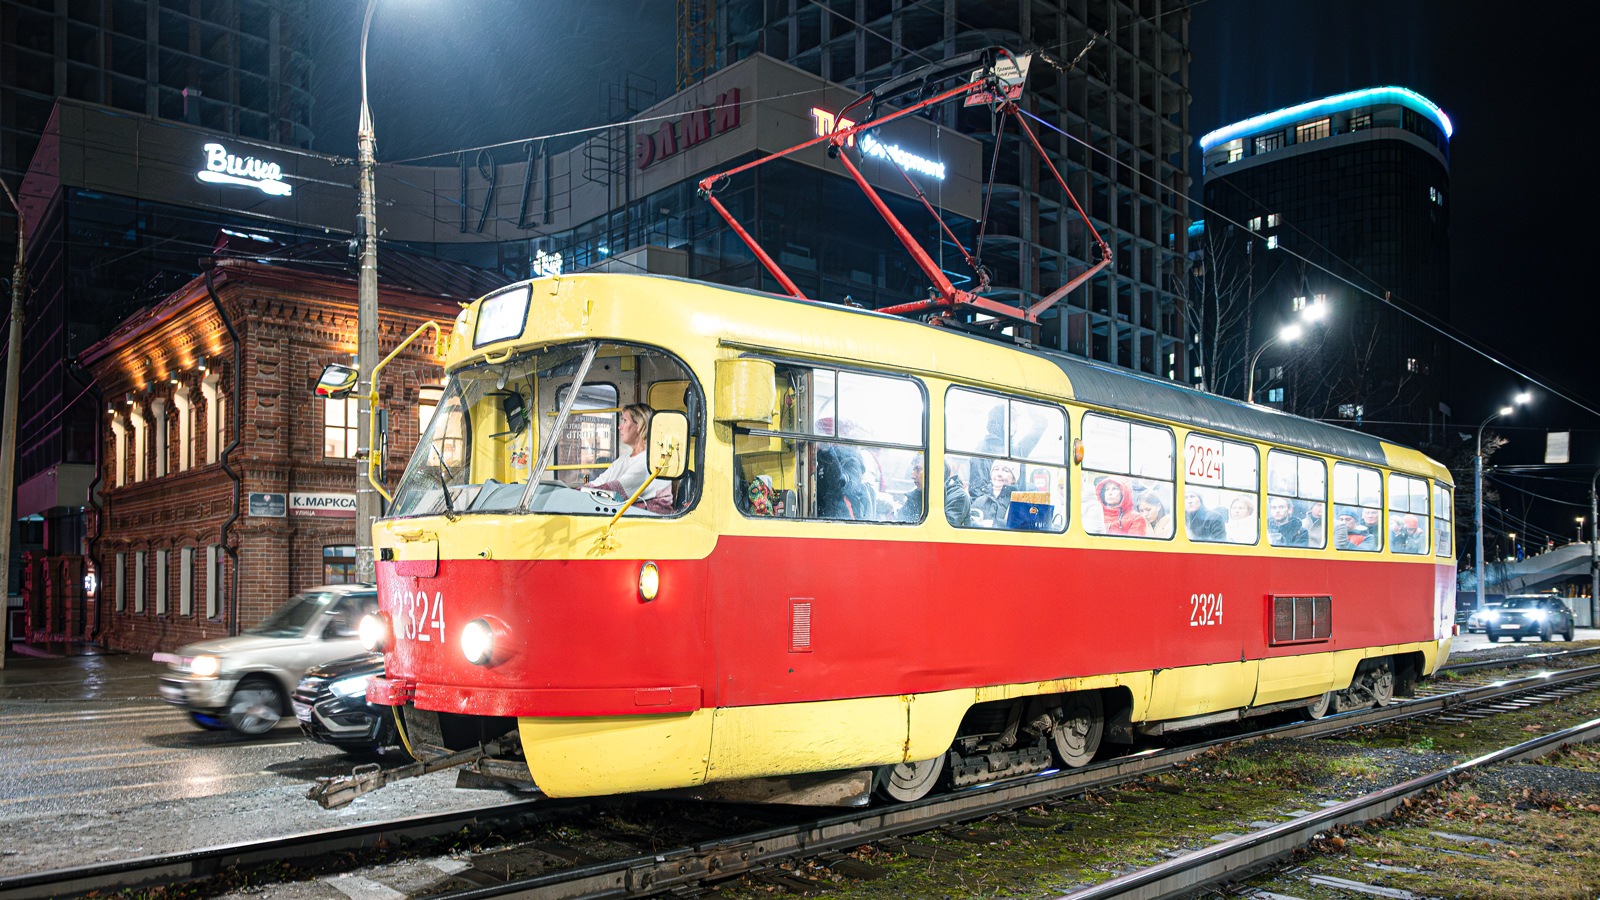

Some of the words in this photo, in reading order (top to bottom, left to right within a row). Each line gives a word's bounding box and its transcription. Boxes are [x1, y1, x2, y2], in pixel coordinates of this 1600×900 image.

[456, 138, 549, 233] 1921
[1189, 445, 1220, 479] 2324
[393, 591, 446, 643] 2324
[1190, 593, 1223, 626] 2324
